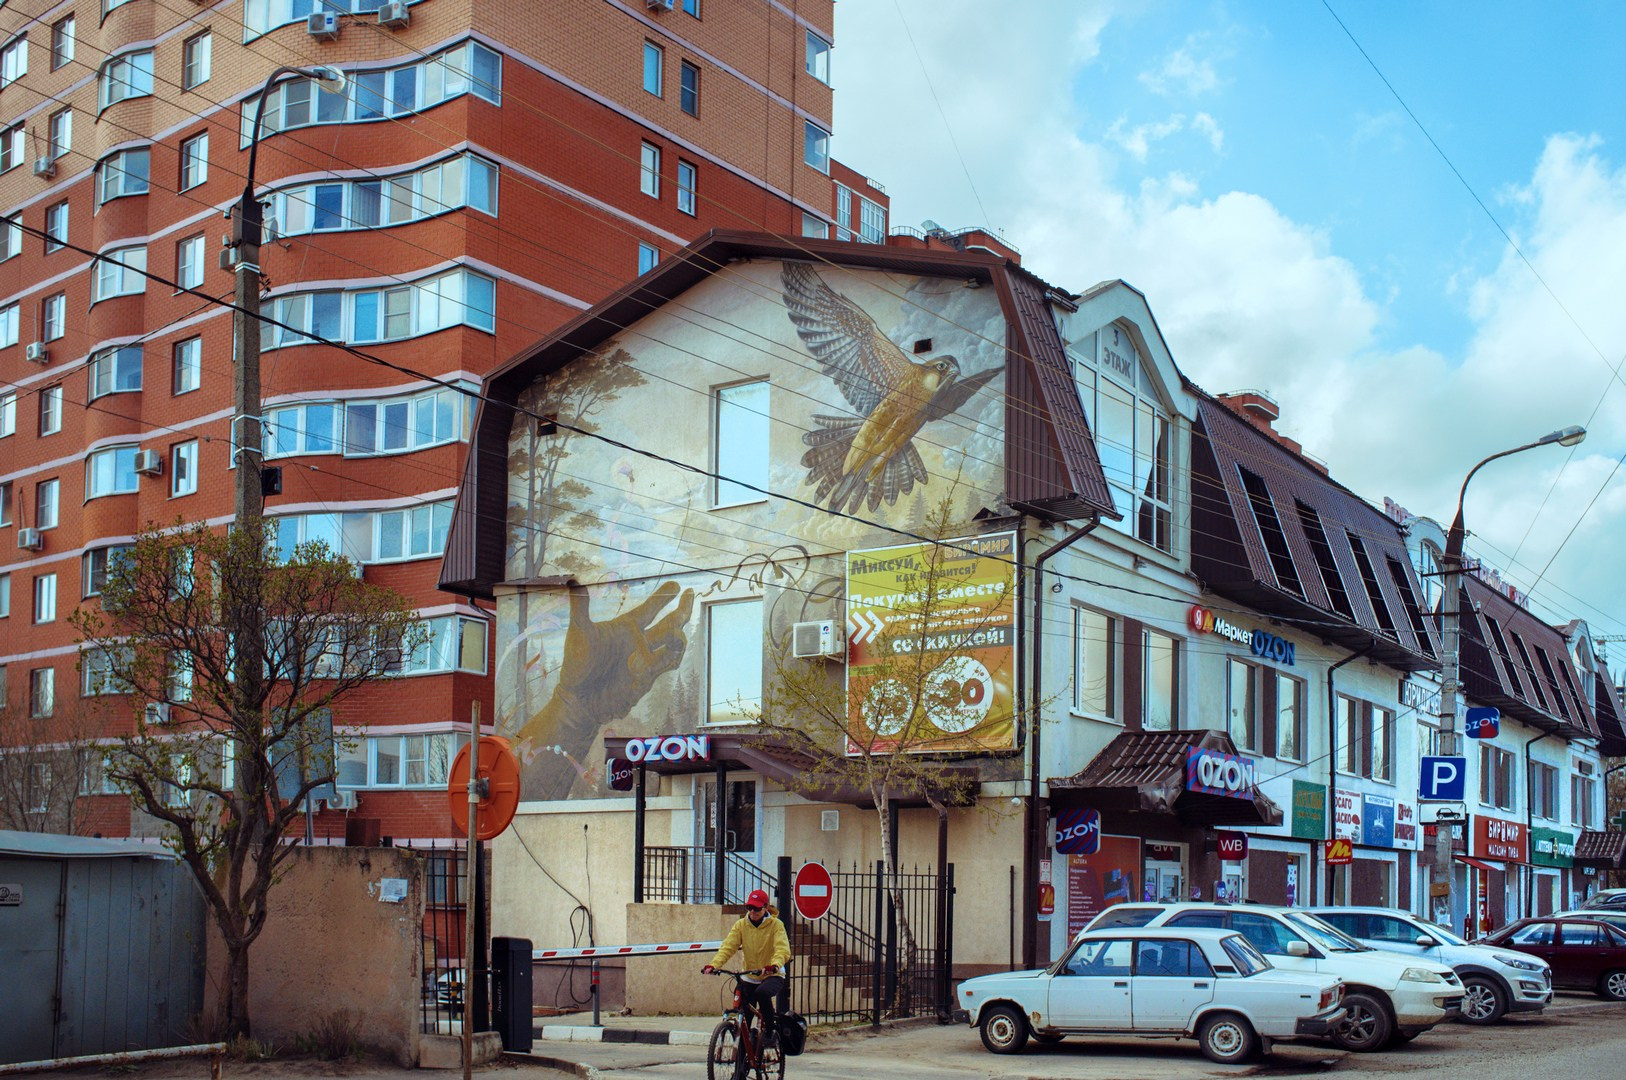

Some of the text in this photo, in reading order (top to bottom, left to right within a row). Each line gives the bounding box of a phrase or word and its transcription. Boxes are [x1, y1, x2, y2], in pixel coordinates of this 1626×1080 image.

[1113, 328, 1120, 347] 3
[1103, 346, 1132, 379] ЭТАЖ
[1214, 617, 1253, 645] Маркет
[1252, 629, 1295, 666] OZON
[1465, 715, 1499, 732] OZON
[625, 736, 709, 762] OZON
[611, 769, 634, 782] OZON
[1197, 754, 1253, 793] OZON
[1431, 761, 1457, 796] P
[1056, 819, 1098, 843] OZON
[1220, 839, 1243, 851] WB
